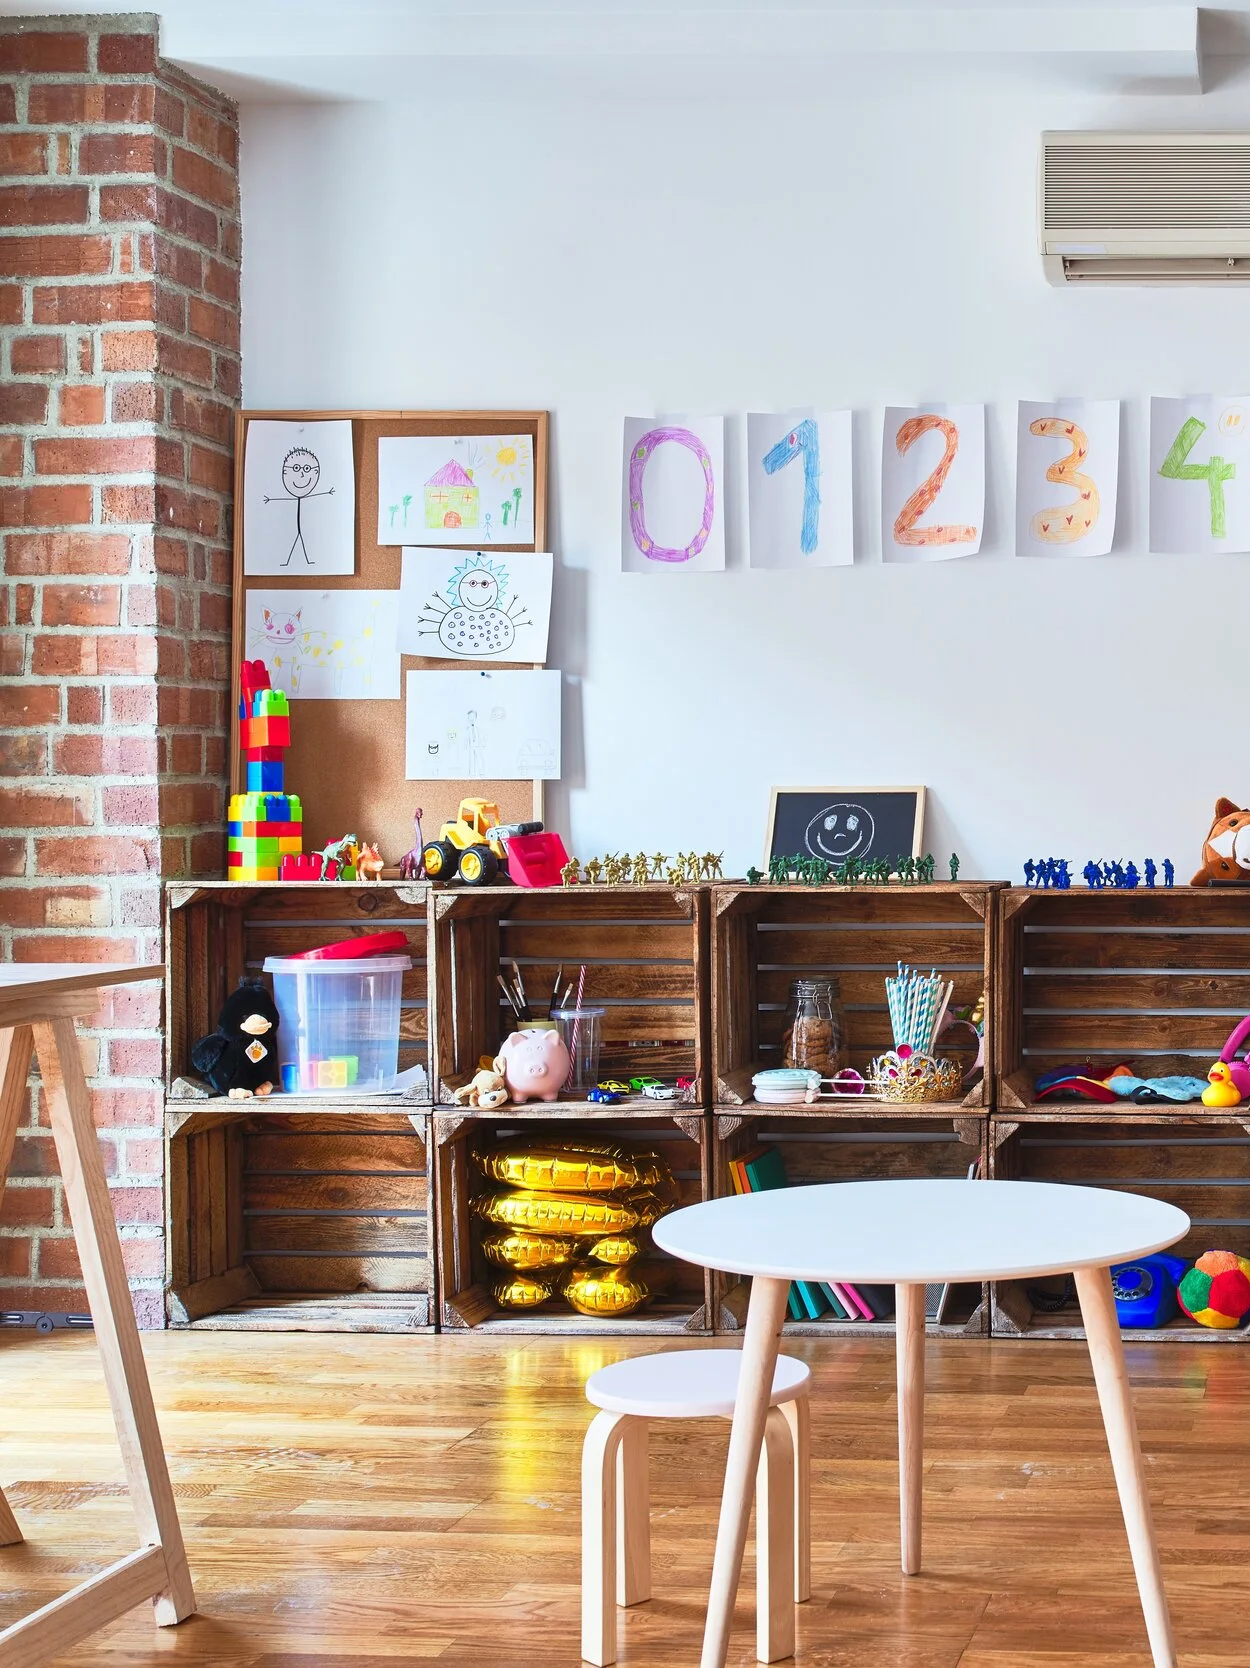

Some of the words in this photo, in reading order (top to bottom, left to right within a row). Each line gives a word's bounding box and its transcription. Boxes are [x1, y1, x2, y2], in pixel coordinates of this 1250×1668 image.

[628, 427, 715, 563] 0
[762, 418, 823, 555] 1
[894, 414, 977, 547] 2
[1029, 417, 1100, 544] 3
[1158, 416, 1237, 538] 4
